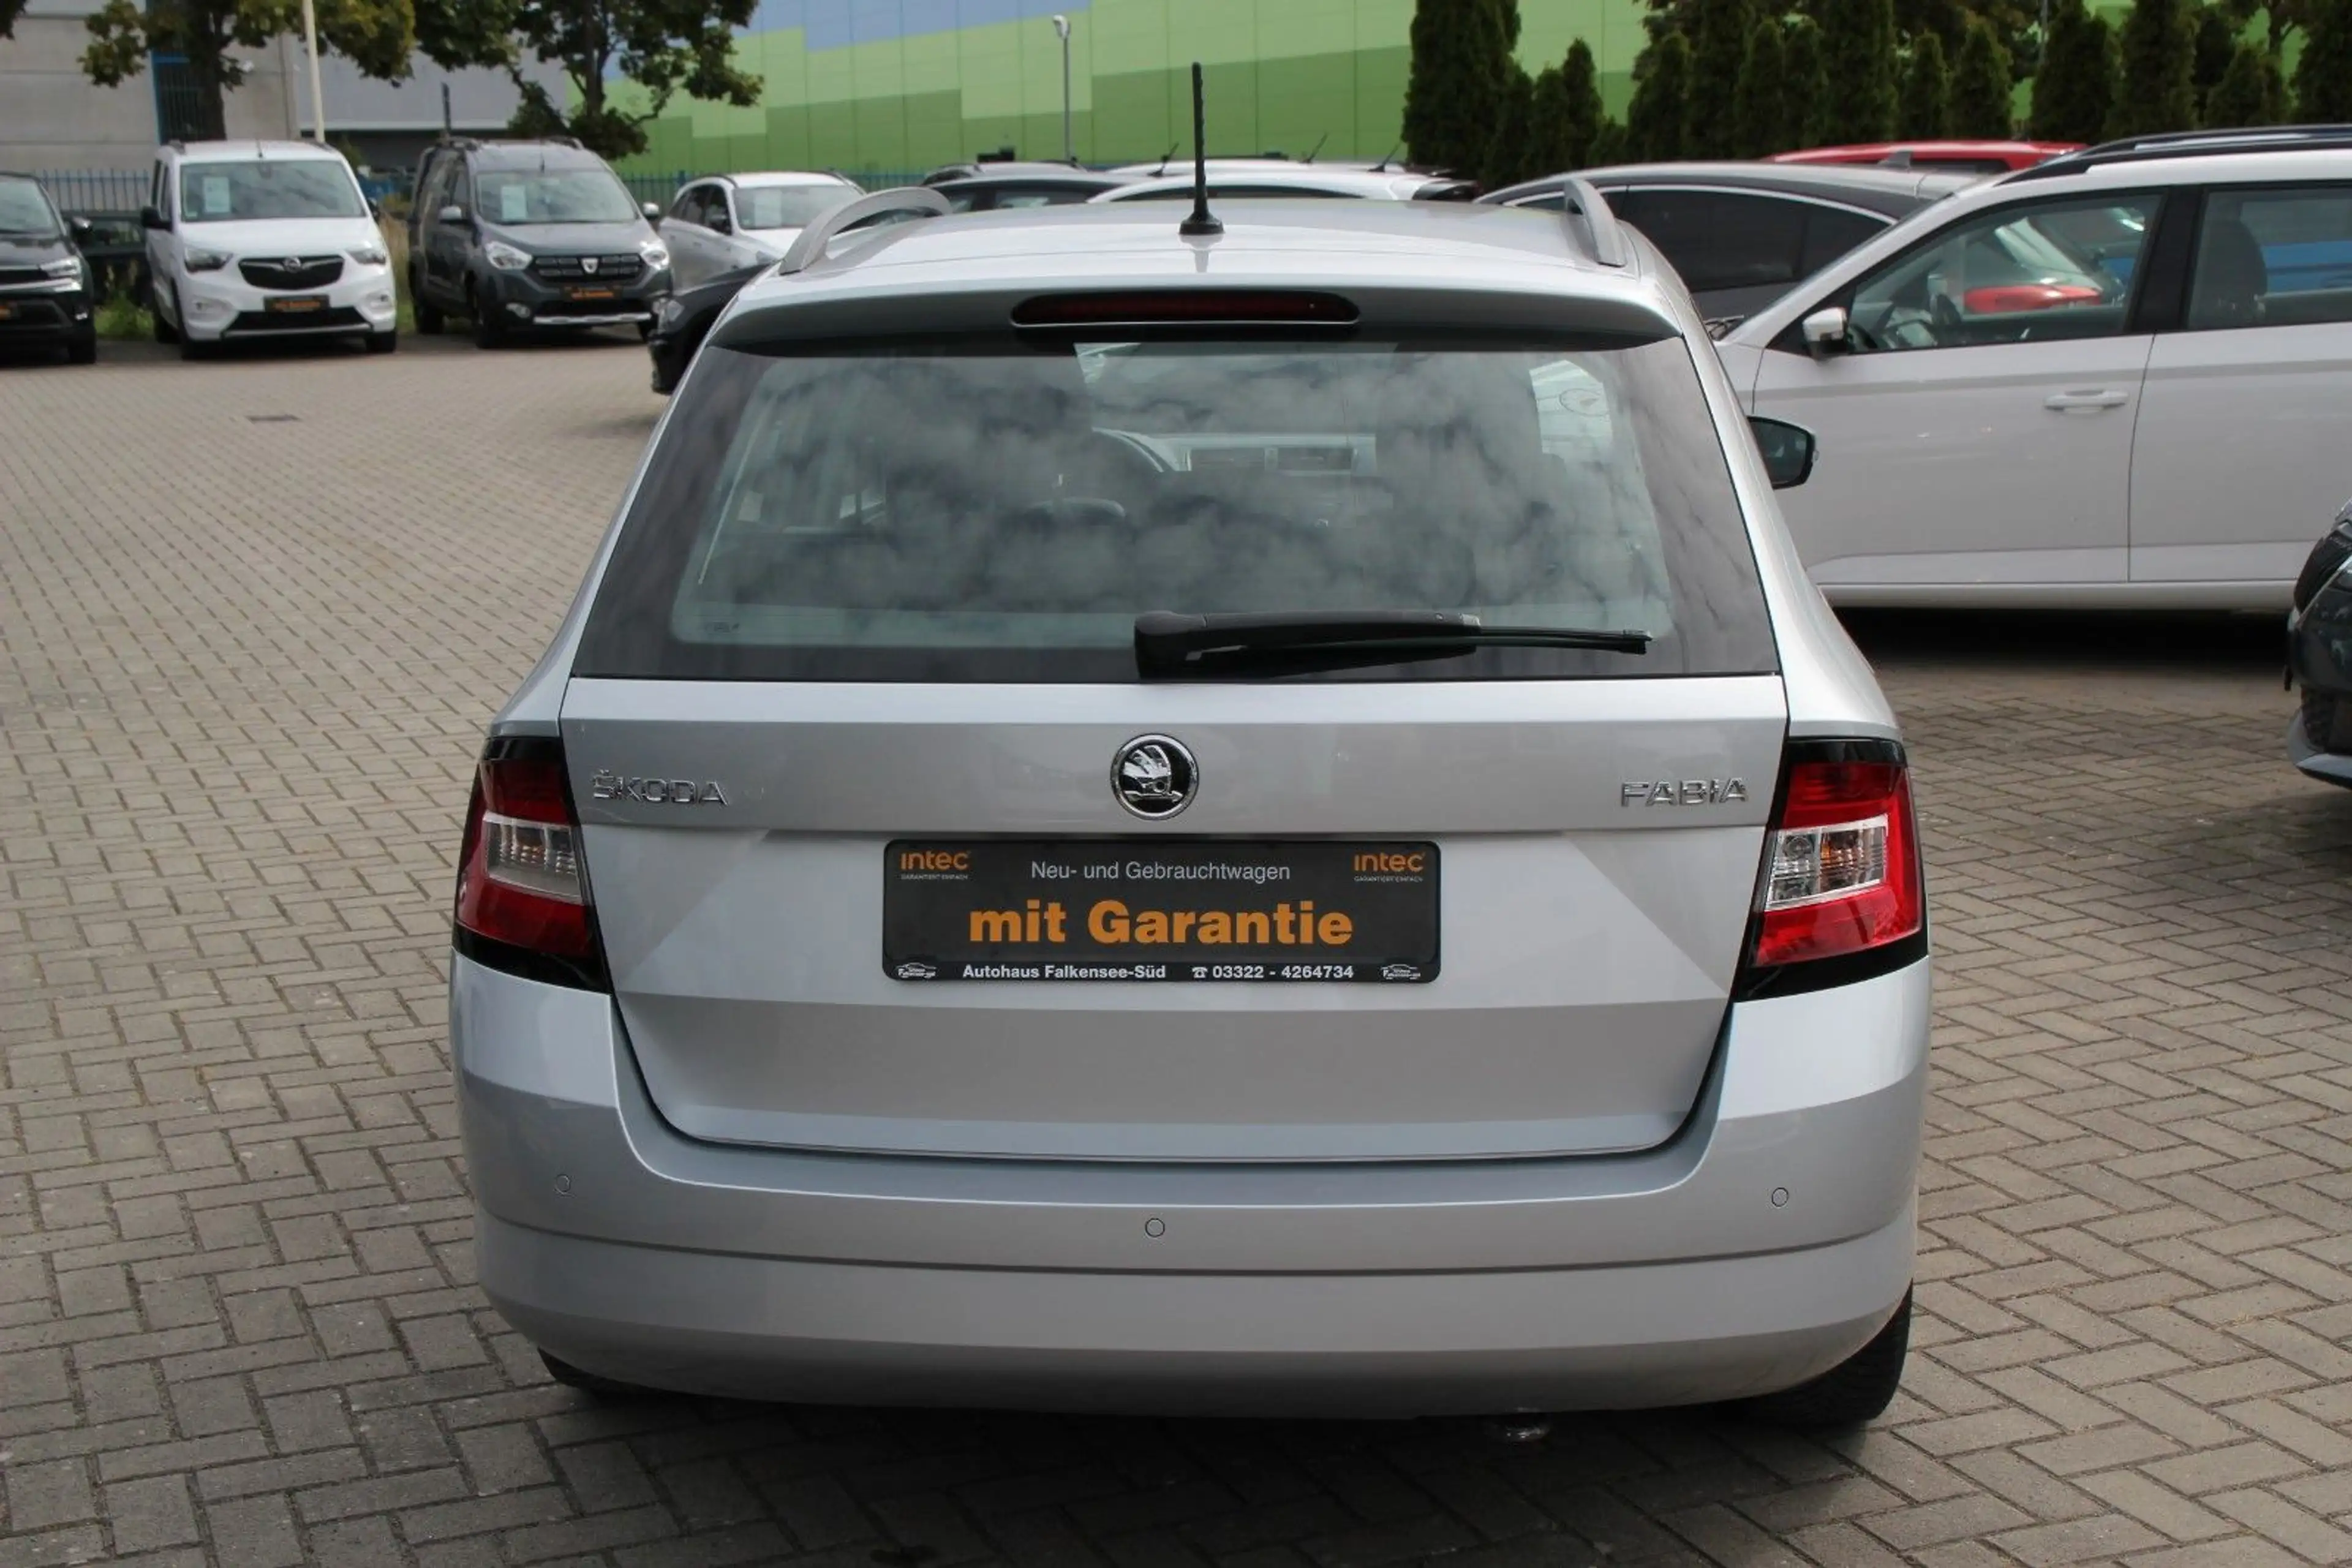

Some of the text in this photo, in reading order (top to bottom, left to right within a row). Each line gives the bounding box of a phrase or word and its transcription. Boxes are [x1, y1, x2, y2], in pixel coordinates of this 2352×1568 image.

[592, 769, 729, 806] ŠKODA
[1621, 777, 1749, 807] FABIA
[1031, 861, 1291, 884] Neu- und Gebrauchtwagen
[970, 899, 1352, 944] mit Garantie
[963, 965, 1166, 978] Autohaus Falkensee-Süd
[1212, 965, 1264, 978] 03322
[1281, 965, 1354, 978] 4264734
